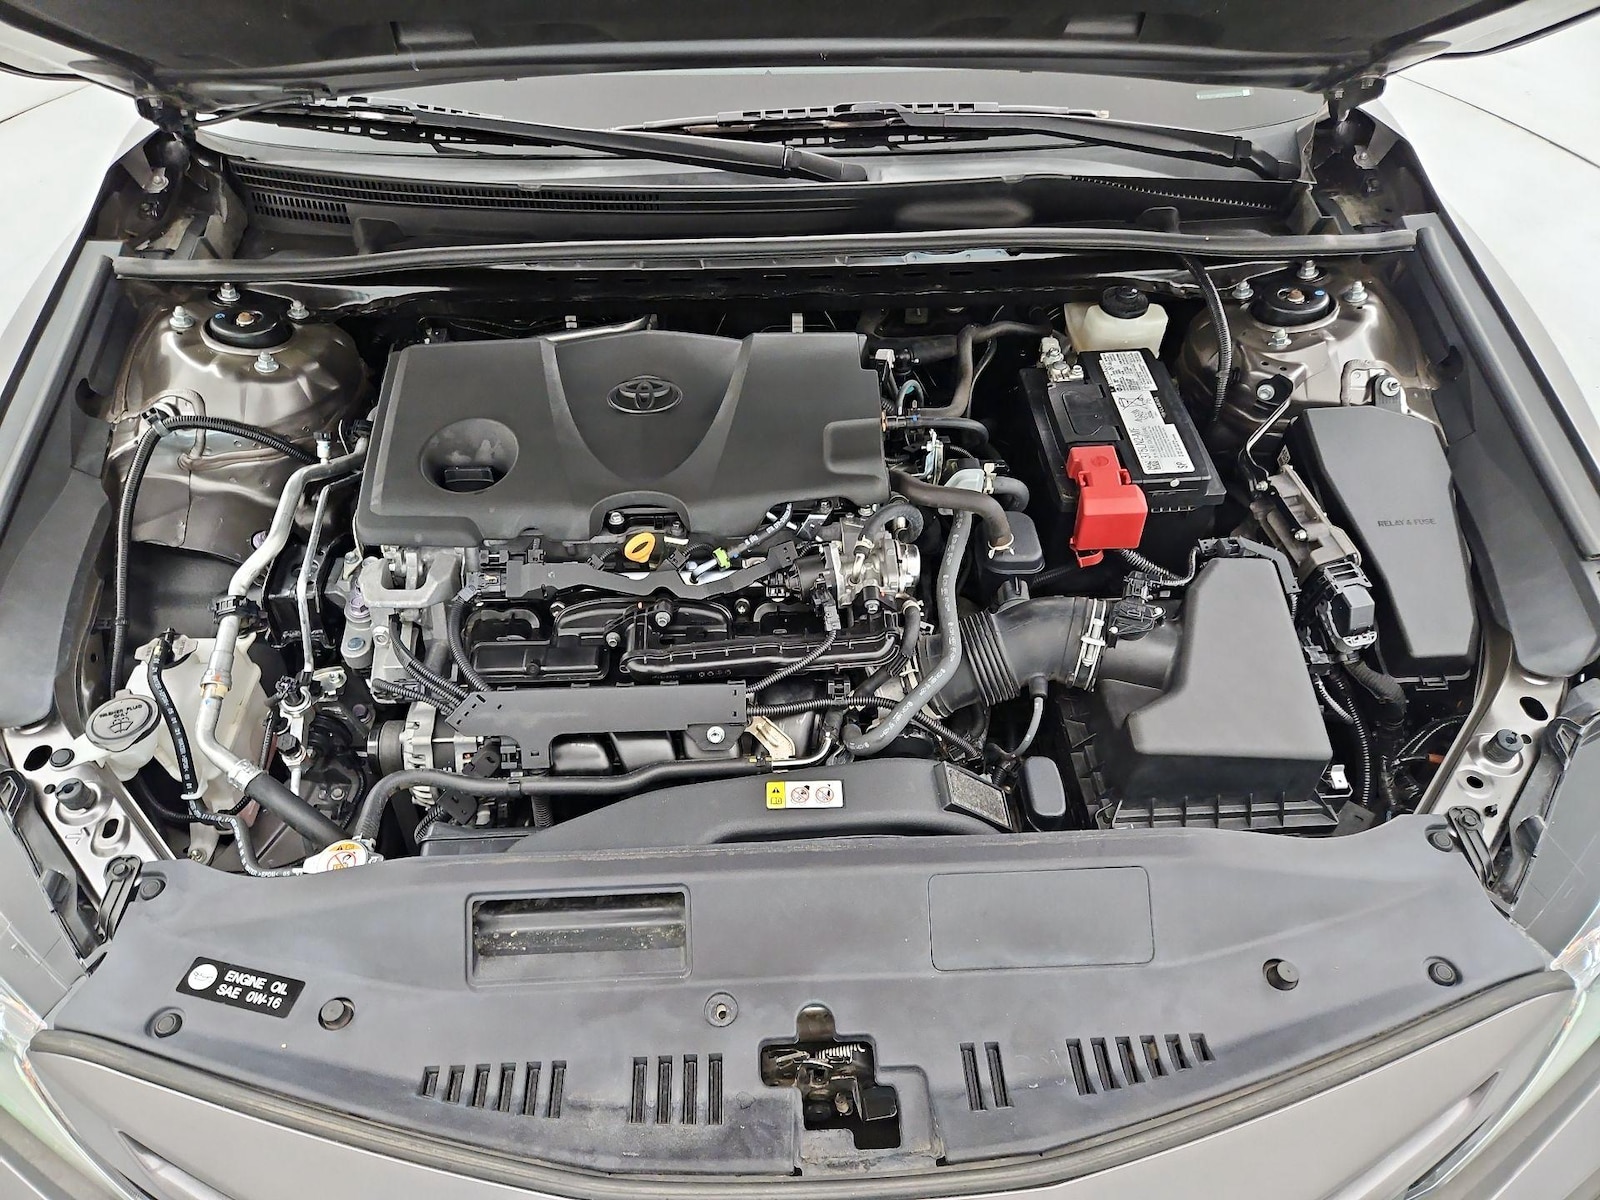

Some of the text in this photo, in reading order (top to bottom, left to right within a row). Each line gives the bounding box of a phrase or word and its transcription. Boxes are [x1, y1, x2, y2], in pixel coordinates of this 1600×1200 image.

[1377, 519, 1404, 527] RELAY
[1413, 518, 1437, 526] FUSE
[224, 969, 268, 990] ENGINE
[270, 981, 288, 995] OIL
[215, 983, 283, 1009] SAE 0W-16
